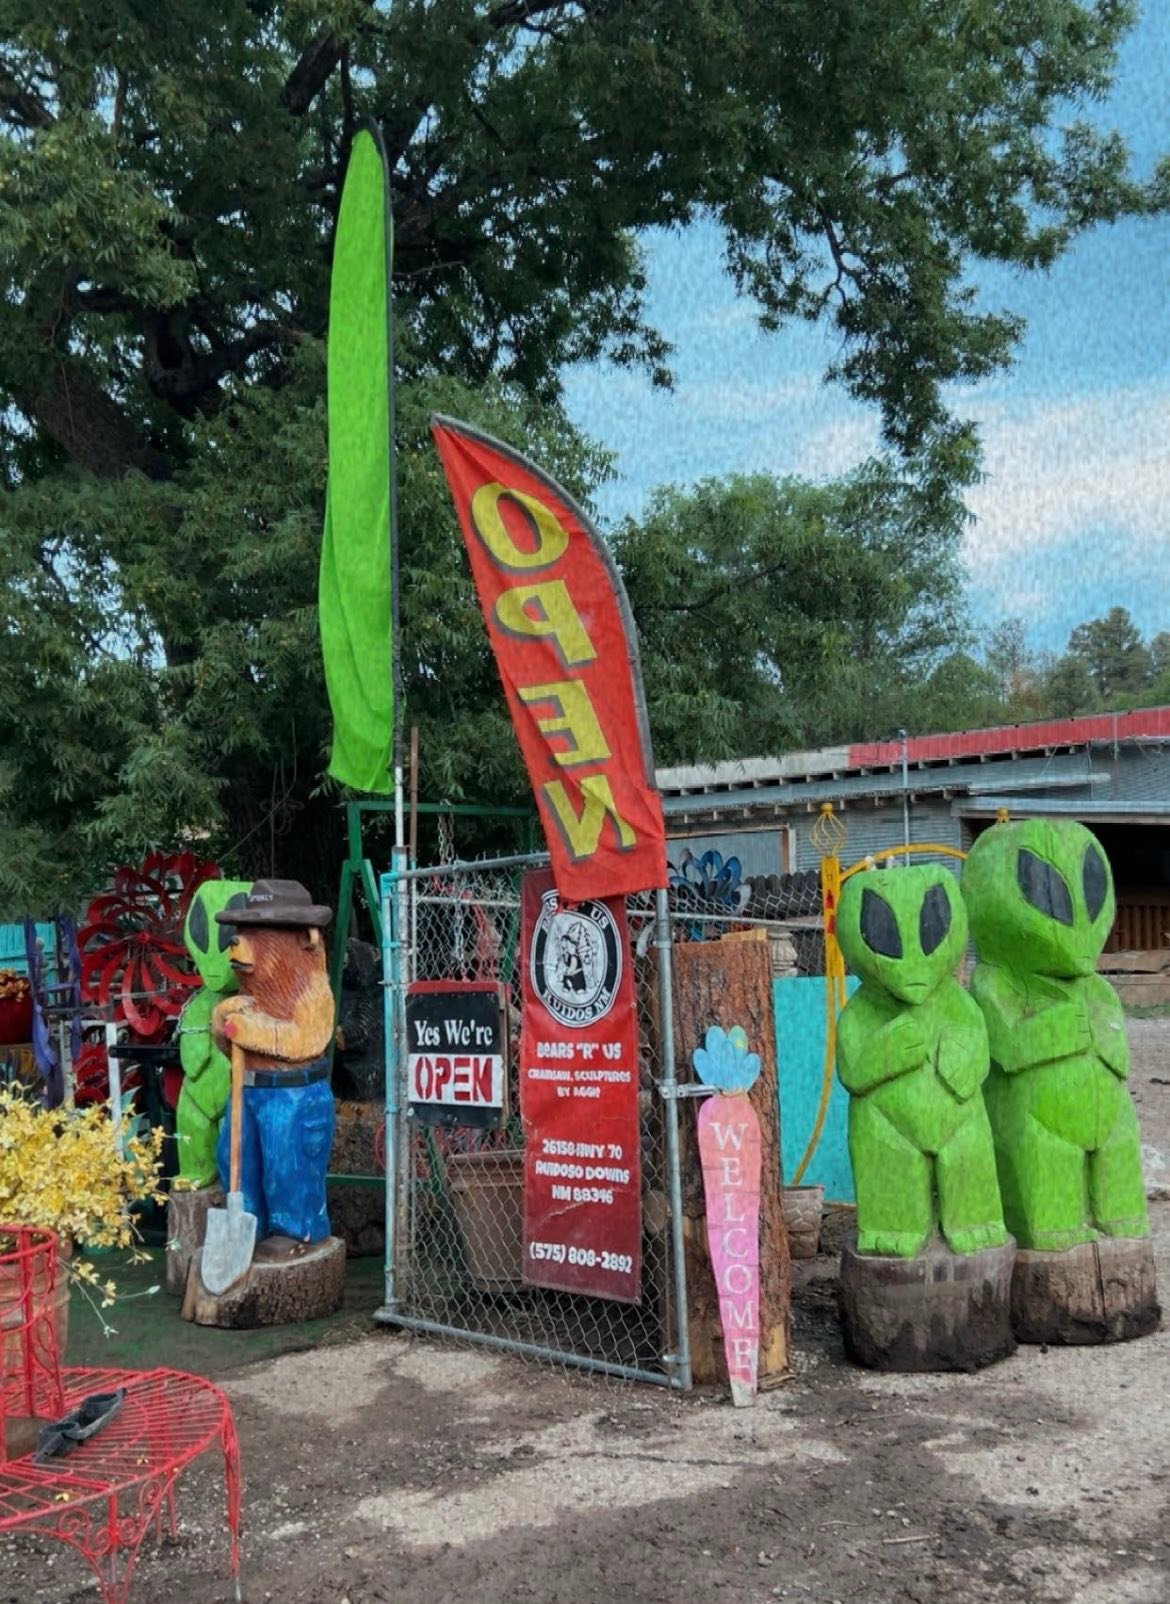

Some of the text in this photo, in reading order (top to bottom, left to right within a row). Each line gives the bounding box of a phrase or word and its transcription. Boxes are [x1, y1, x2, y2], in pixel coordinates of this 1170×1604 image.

[590, 907, 610, 930] US
[596, 986, 612, 1014] NM
[414, 1019, 493, 1046] Yes We're
[536, 1042, 574, 1059] BEARS
[602, 1042, 622, 1060] US
[415, 1056, 493, 1102] OPEN
[557, 1086, 570, 1098] BY
[575, 1142, 605, 1159] HWY
[607, 1144, 623, 1160] 70
[535, 1160, 630, 1184] RUIDOSO DOWNS
[552, 1184, 571, 1200] NM
[529, 1241, 633, 1273] (575) 808-2892
[710, 1122, 757, 1369] WELCOME
